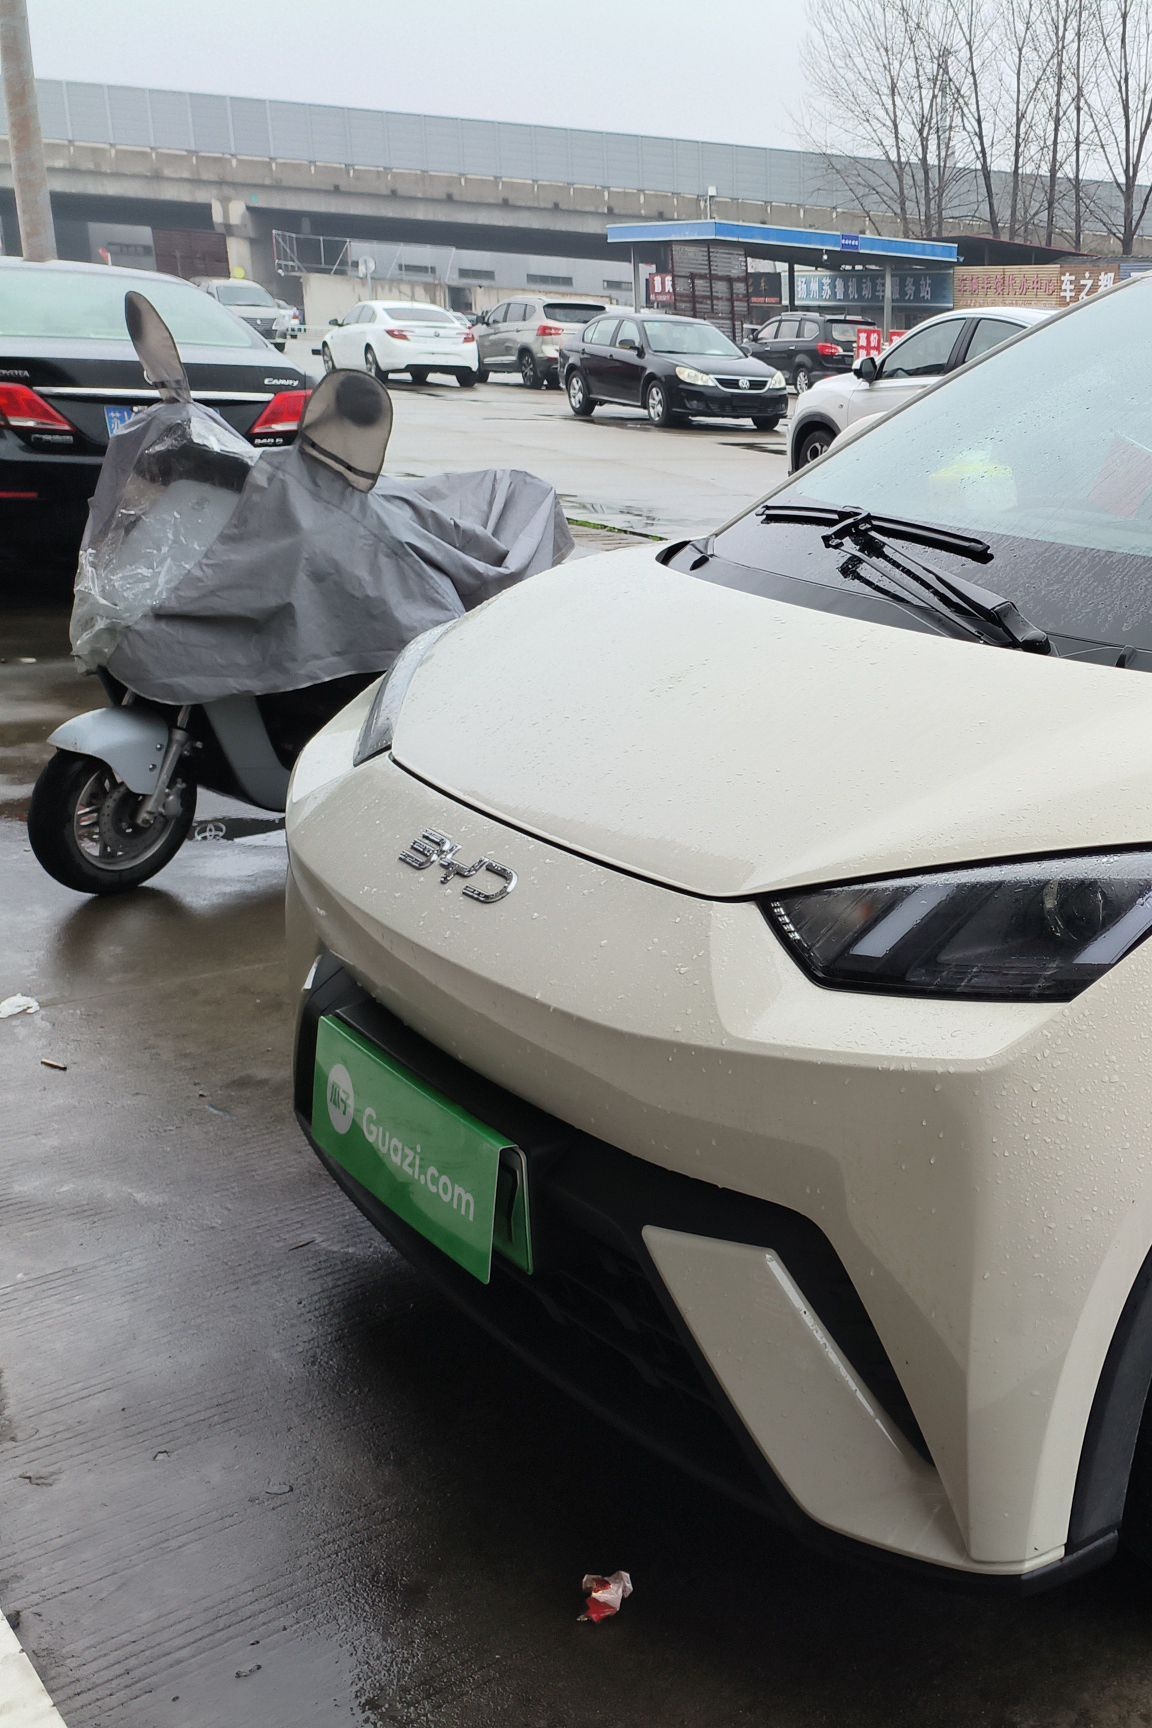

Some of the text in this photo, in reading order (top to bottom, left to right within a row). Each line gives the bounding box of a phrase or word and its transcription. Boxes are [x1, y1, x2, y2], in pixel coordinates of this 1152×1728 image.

[798, 276, 932, 300] 扬州苏鲁机动车服务站
[0, 368, 30, 377] OYOTA
[398, 827, 519, 904] BYD
[362, 1106, 475, 1221] Guazi.com
